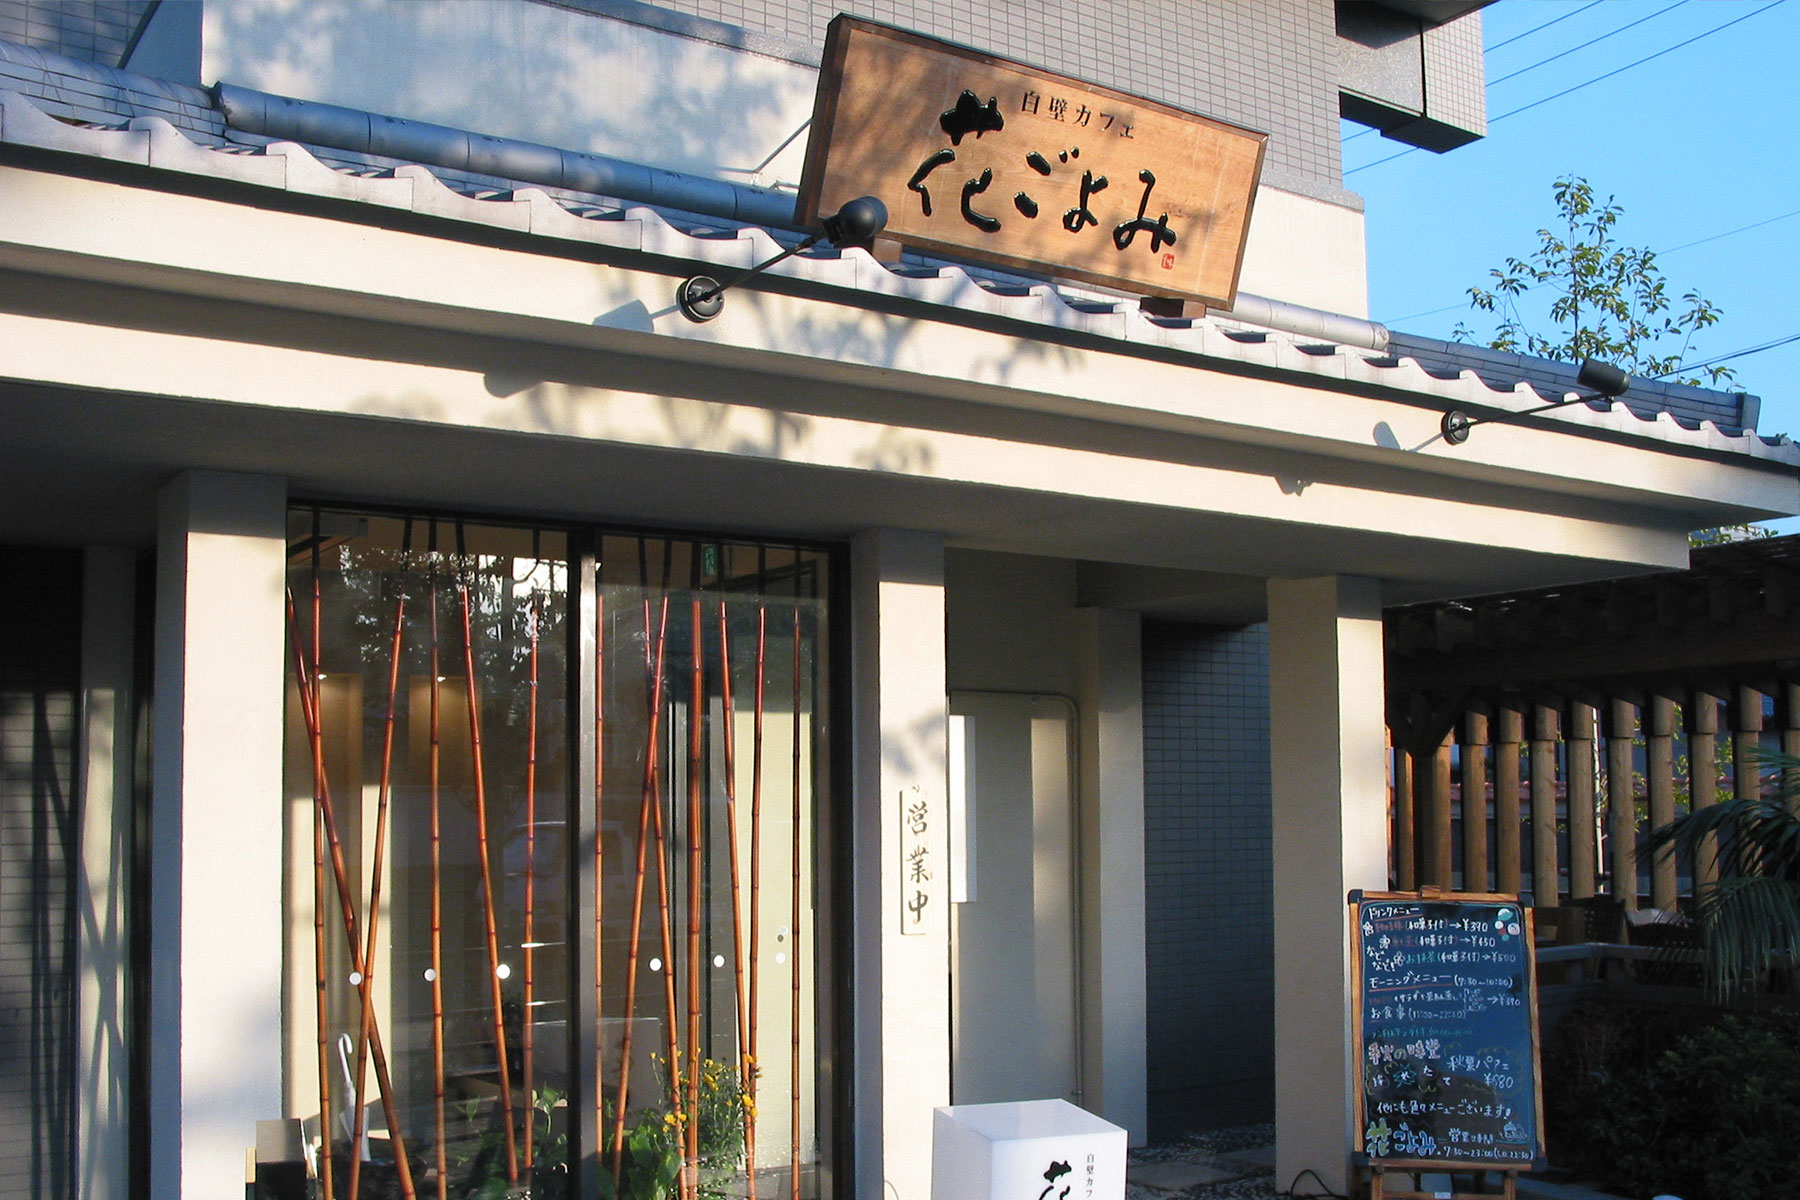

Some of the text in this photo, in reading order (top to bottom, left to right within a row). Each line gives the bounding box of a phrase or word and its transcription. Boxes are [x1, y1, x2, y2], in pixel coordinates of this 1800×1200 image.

[1020, 90, 1134, 140] 白壁カフェ
[906, 801, 929, 923] 営業中
[1369, 906, 1420, 920] ドリンクメニュー
[1369, 970, 1452, 988] モーニングメニュー
